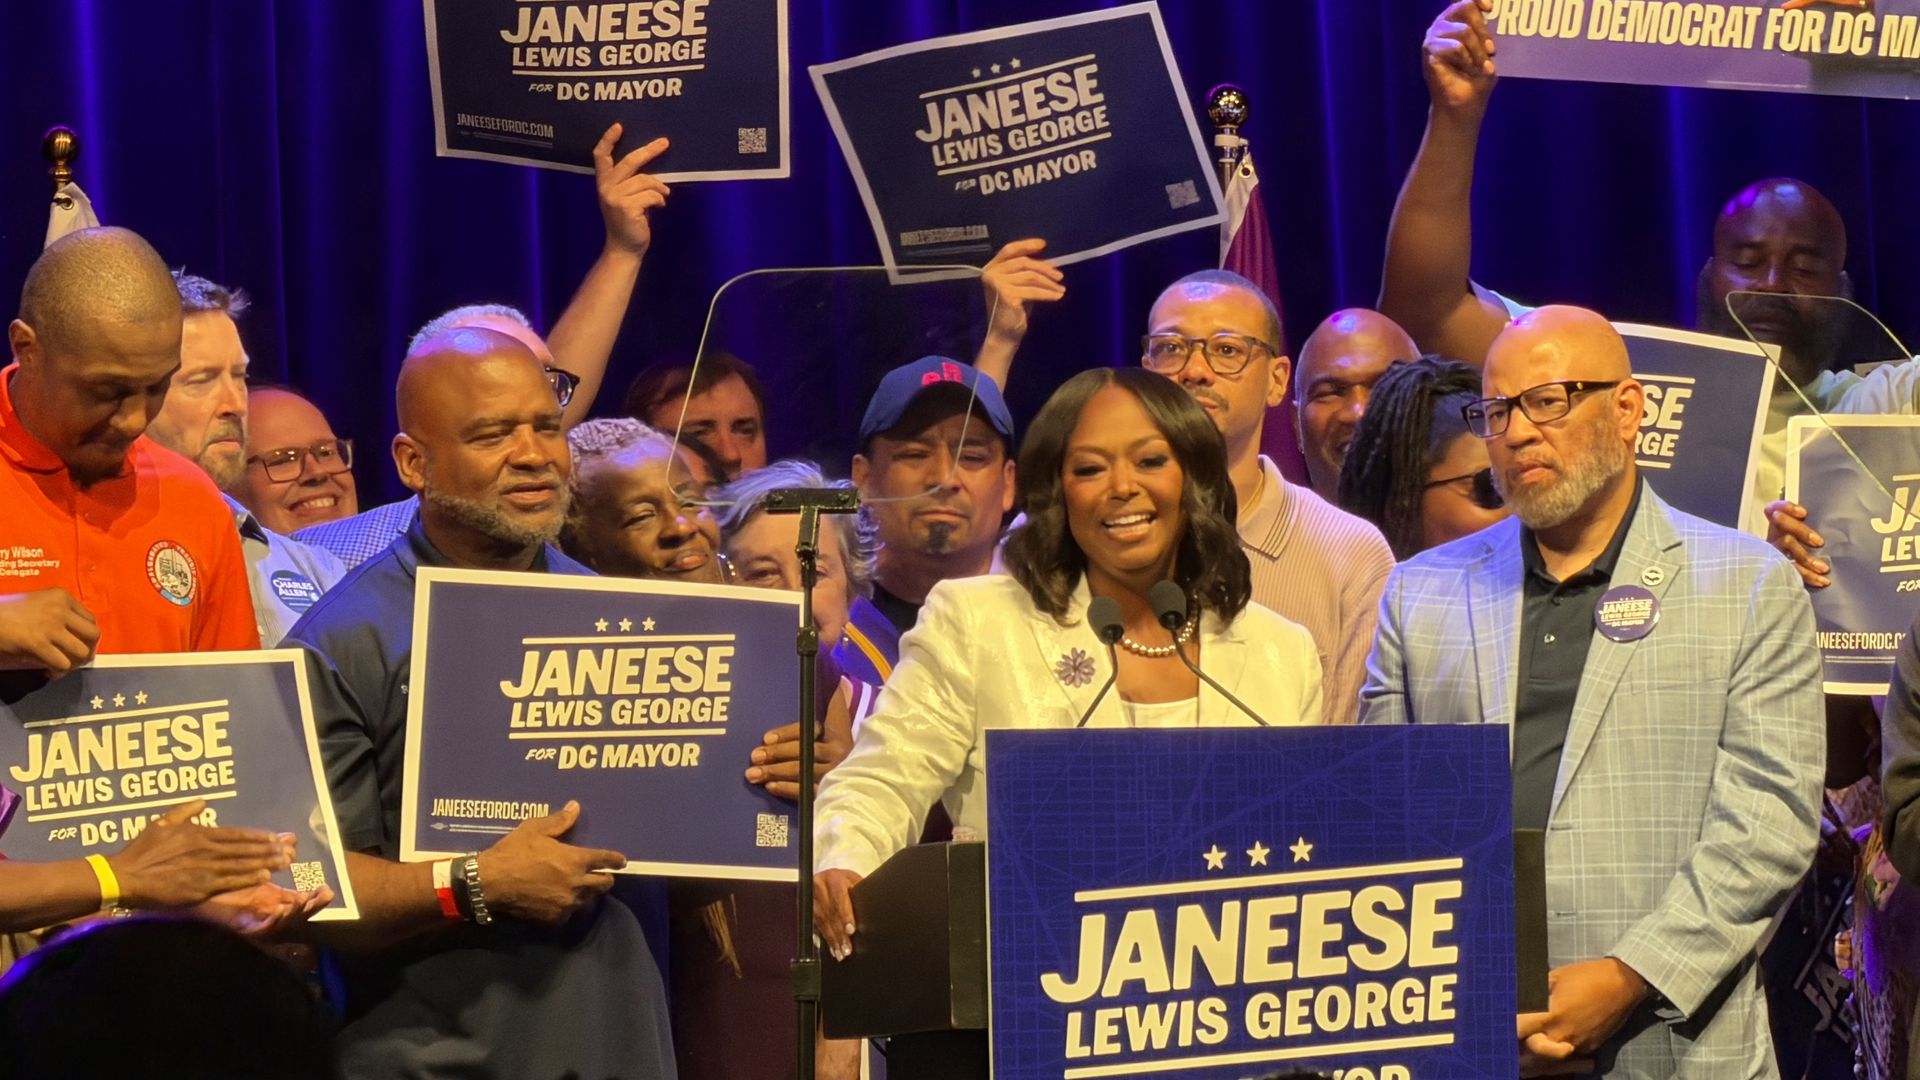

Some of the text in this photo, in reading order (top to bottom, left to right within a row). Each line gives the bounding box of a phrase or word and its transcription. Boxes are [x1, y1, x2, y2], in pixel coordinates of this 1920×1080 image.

[501, 0, 709, 43] JANEESE
[1586, 0, 1763, 49] DEMOCRAT
[1763, 8, 1826, 53] FOR
[1829, 12, 1876, 56] DC
[1878, 15, 1920, 59] M
[513, 39, 706, 67] LEWIS GEORGE
[528, 78, 682, 101] FOR DC MAYOR
[915, 64, 1105, 143] JANEESE
[457, 113, 554, 138] JANEESEFORDC.COM
[932, 105, 1110, 166] LEWIS GEORGE
[979, 171, 1011, 195] DC
[1013, 150, 1097, 188] MAYOR
[11, 546, 44, 558] Wilson
[17, 559, 61, 568] Secretary
[500, 646, 735, 698] JANEESE
[510, 697, 731, 728] LEWIS GEORGE
[9, 712, 232, 782] JANEESE
[525, 743, 700, 769] FOR DC MAYOR
[26, 760, 235, 811] LEWIS GEORGE
[48, 827, 78, 841] FOR
[81, 820, 119, 846] DC
[1040, 880, 1463, 1004] JANEESE
[1065, 974, 1457, 1058] LEWIS GEORGE
